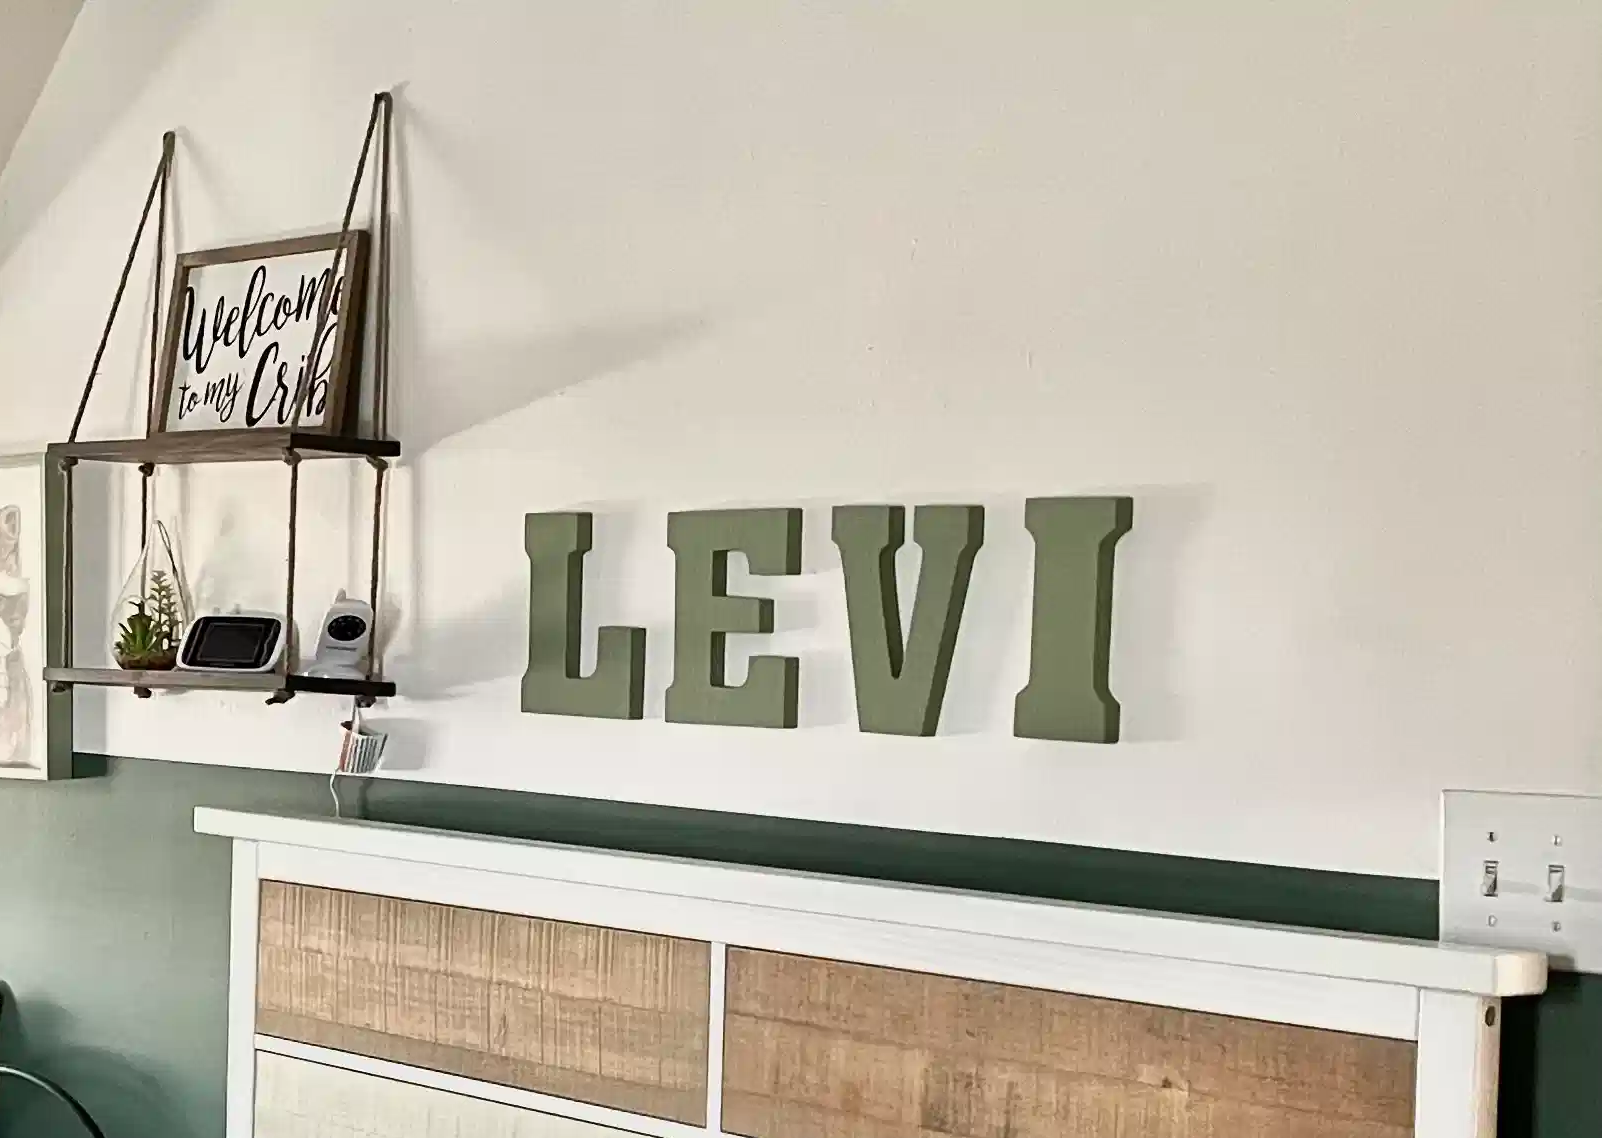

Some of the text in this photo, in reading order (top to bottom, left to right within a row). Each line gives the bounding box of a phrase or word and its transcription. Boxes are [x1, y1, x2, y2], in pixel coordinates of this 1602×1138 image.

[178, 322, 338, 427] to my Crib
[520, 496, 1133, 744] LEVI
